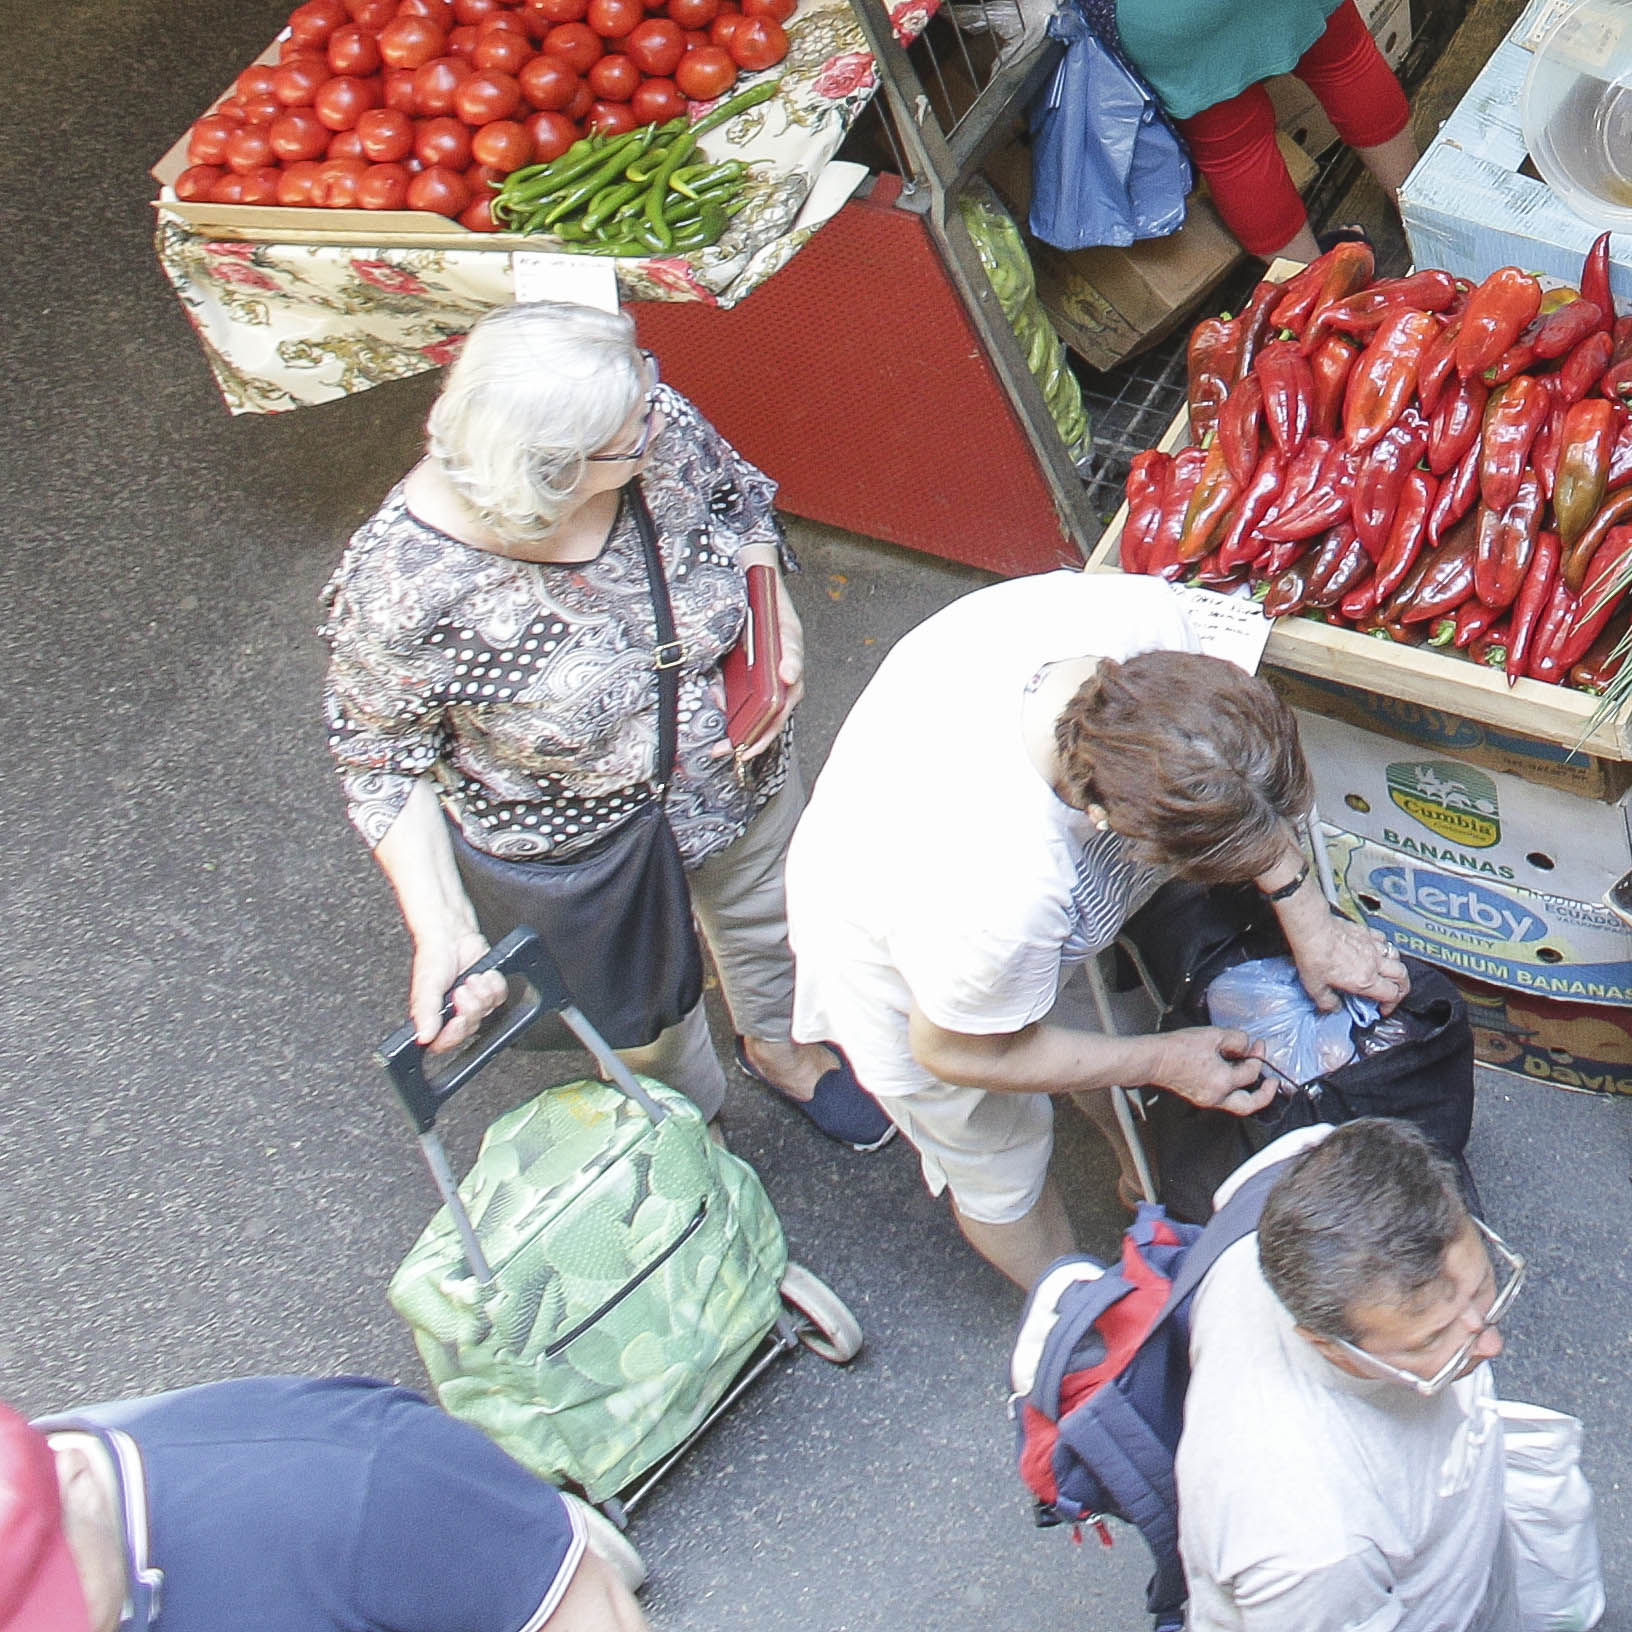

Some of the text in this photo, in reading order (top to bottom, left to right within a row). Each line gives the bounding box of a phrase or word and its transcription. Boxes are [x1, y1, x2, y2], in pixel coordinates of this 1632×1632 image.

[1402, 797, 1494, 837] Cumbia
[1383, 827, 1515, 880] BANANAS
[1381, 866, 1535, 944] derby
[1394, 931, 1509, 980] PREMIUM
[1425, 921, 1496, 950] QUALITY
